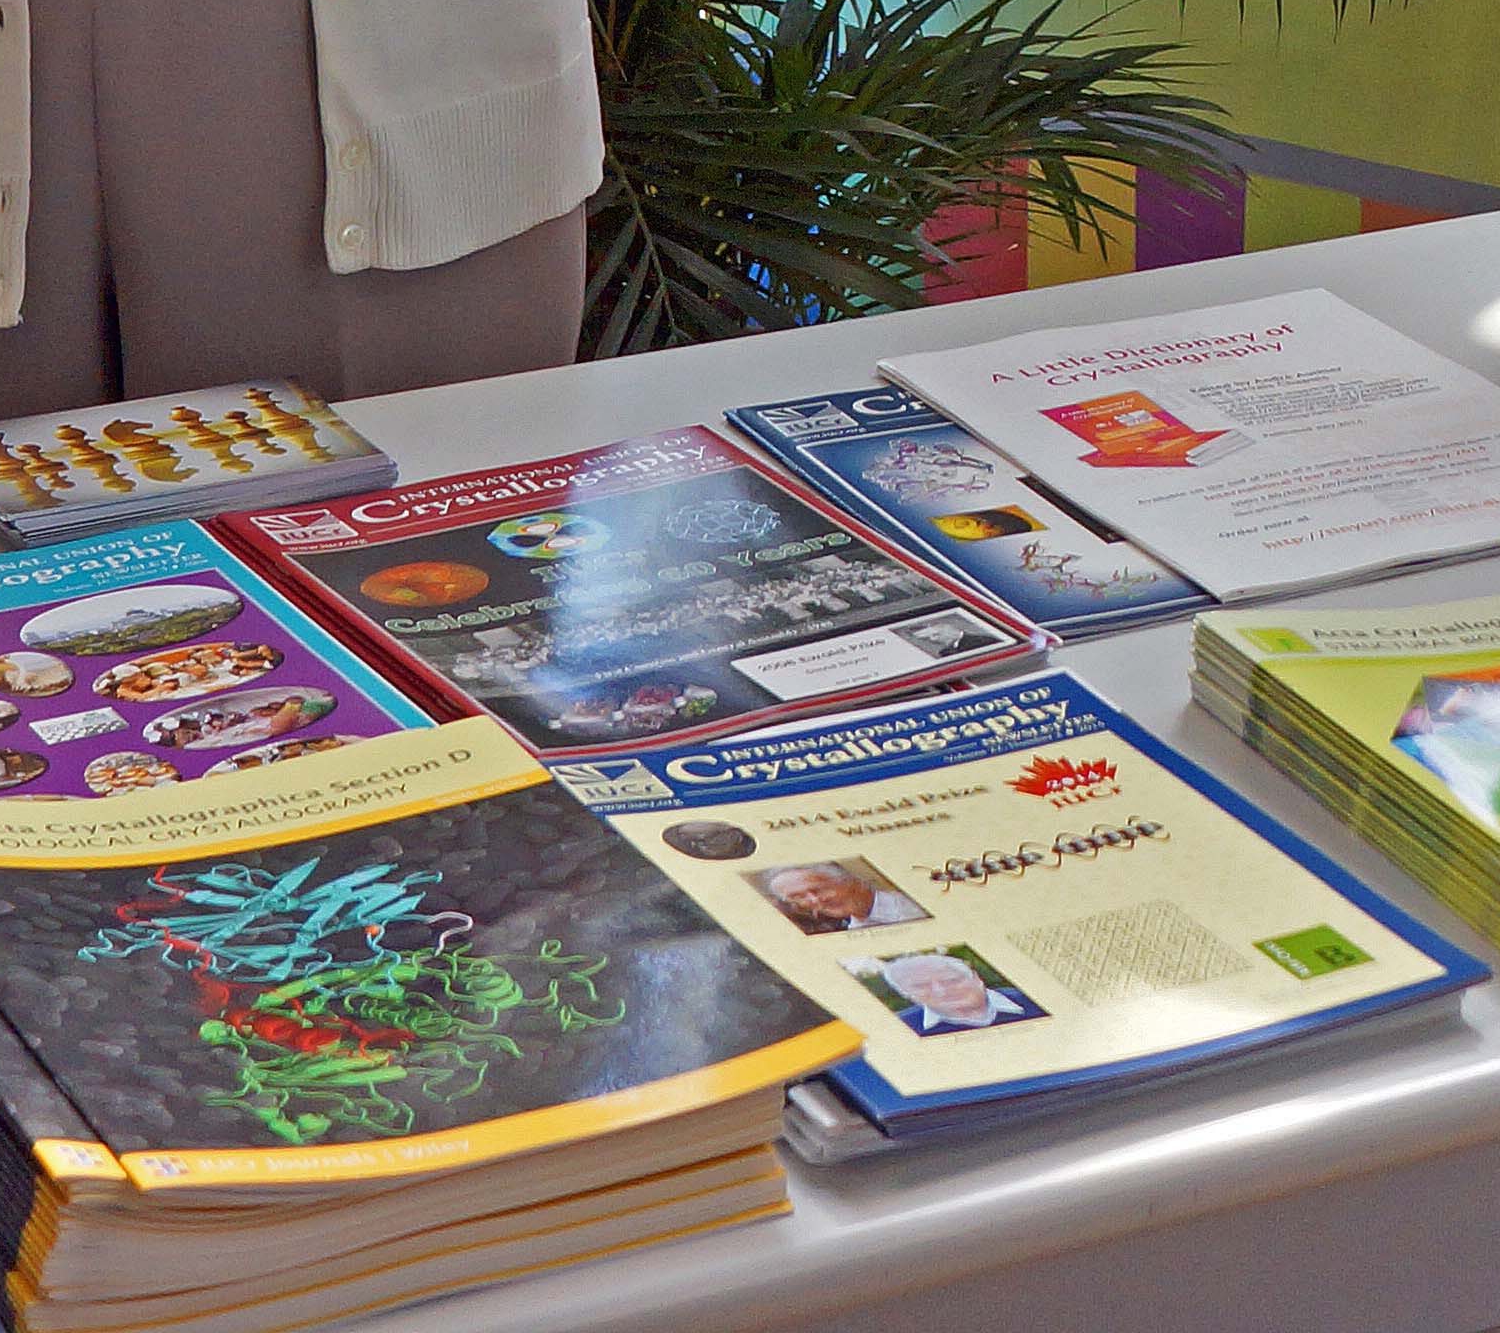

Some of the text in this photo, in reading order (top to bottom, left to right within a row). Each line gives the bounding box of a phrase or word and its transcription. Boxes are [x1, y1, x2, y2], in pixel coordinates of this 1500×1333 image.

[991, 323, 1296, 383] A Little Dictionary of
[1046, 340, 1285, 388] Crystallography
[53, 537, 137, 560] UNION
[142, 531, 173, 543] OF
[665, 699, 1071, 783] Crystallography
[721, 687, 1051, 762] INTERNATIONAL UNION OF
[329, 761, 439, 792] Section
